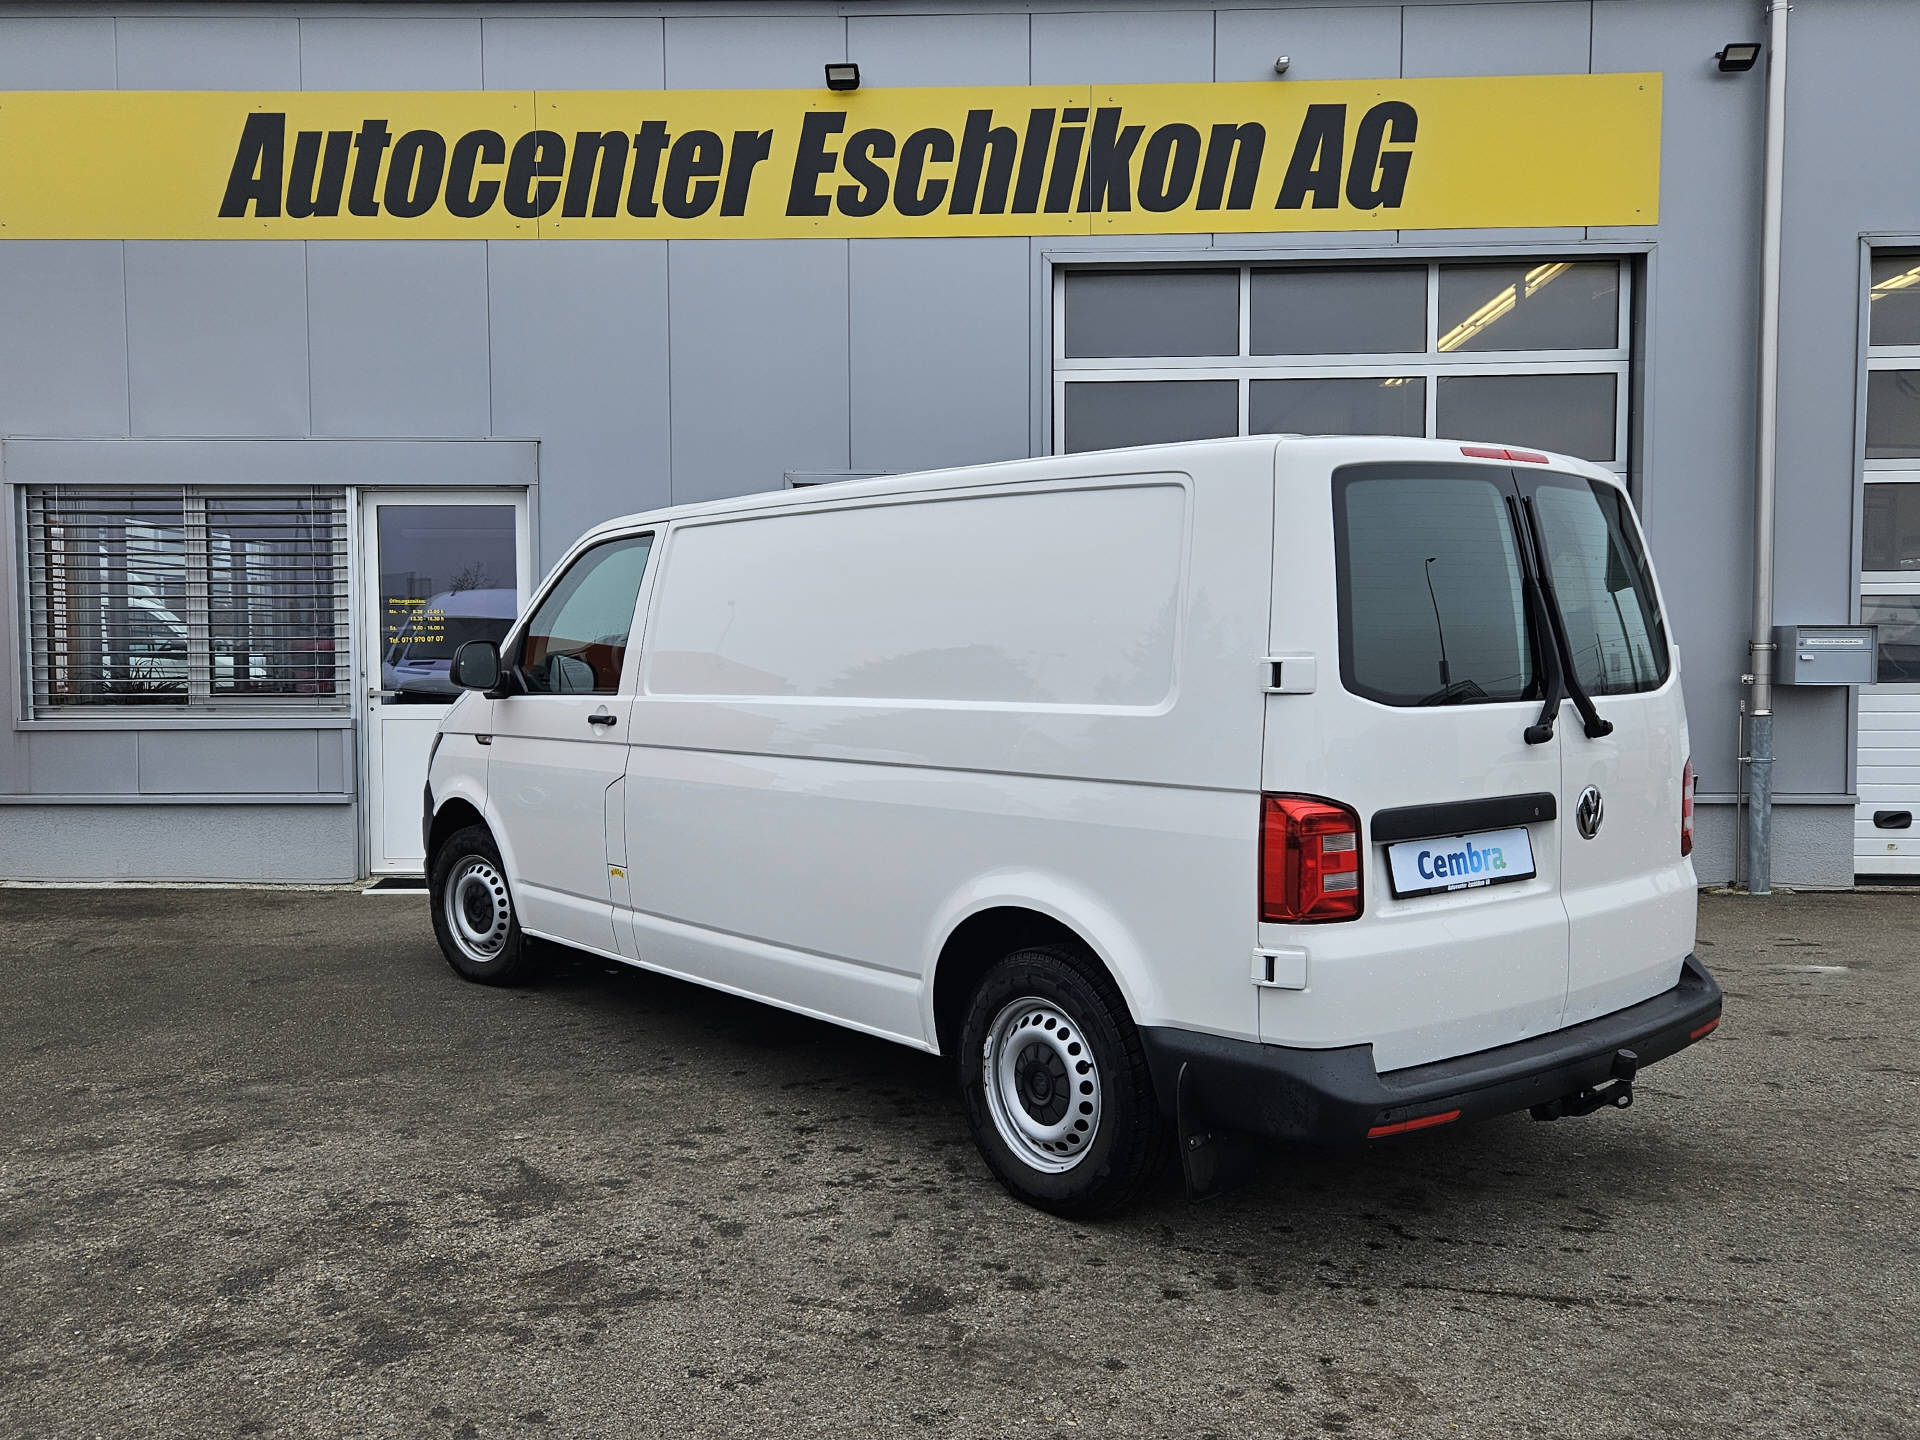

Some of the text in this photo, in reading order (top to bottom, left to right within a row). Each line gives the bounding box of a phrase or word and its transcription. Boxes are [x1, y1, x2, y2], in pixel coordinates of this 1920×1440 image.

[218, 100, 1419, 218] Autocenter Eschlikon AG
[1417, 842, 1507, 880] Cembra
